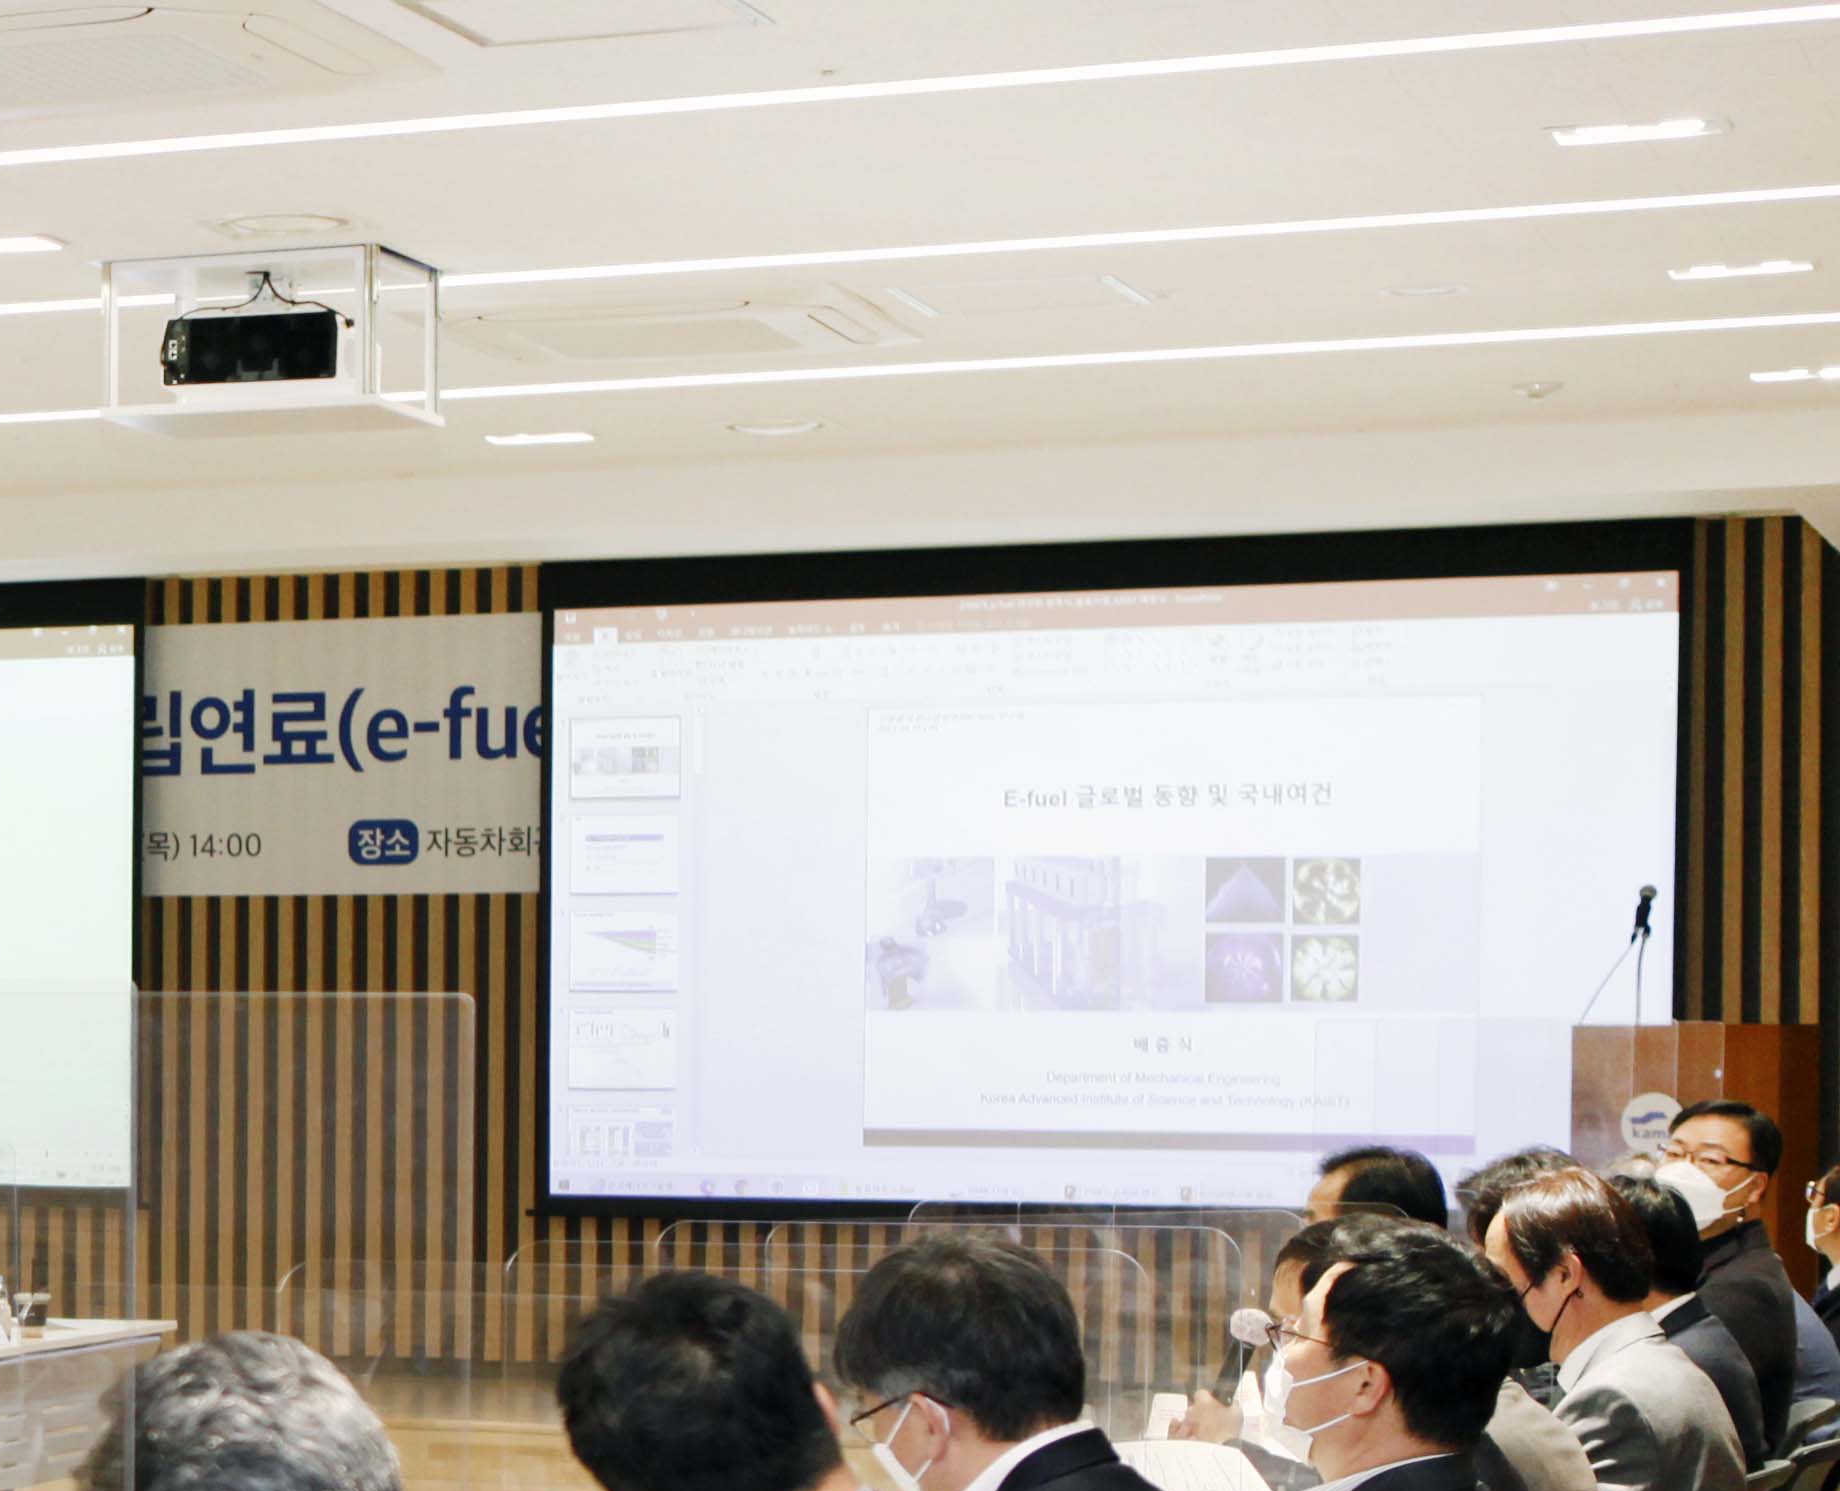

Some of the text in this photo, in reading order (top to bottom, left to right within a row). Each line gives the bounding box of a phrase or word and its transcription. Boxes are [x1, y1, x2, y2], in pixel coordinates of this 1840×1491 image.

[1003, 782, 1332, 809] E-fuel 글로벌 동향 및 국내여건
[143, 832, 261, 861] 목) 14:00
[357, 827, 412, 861] 장소
